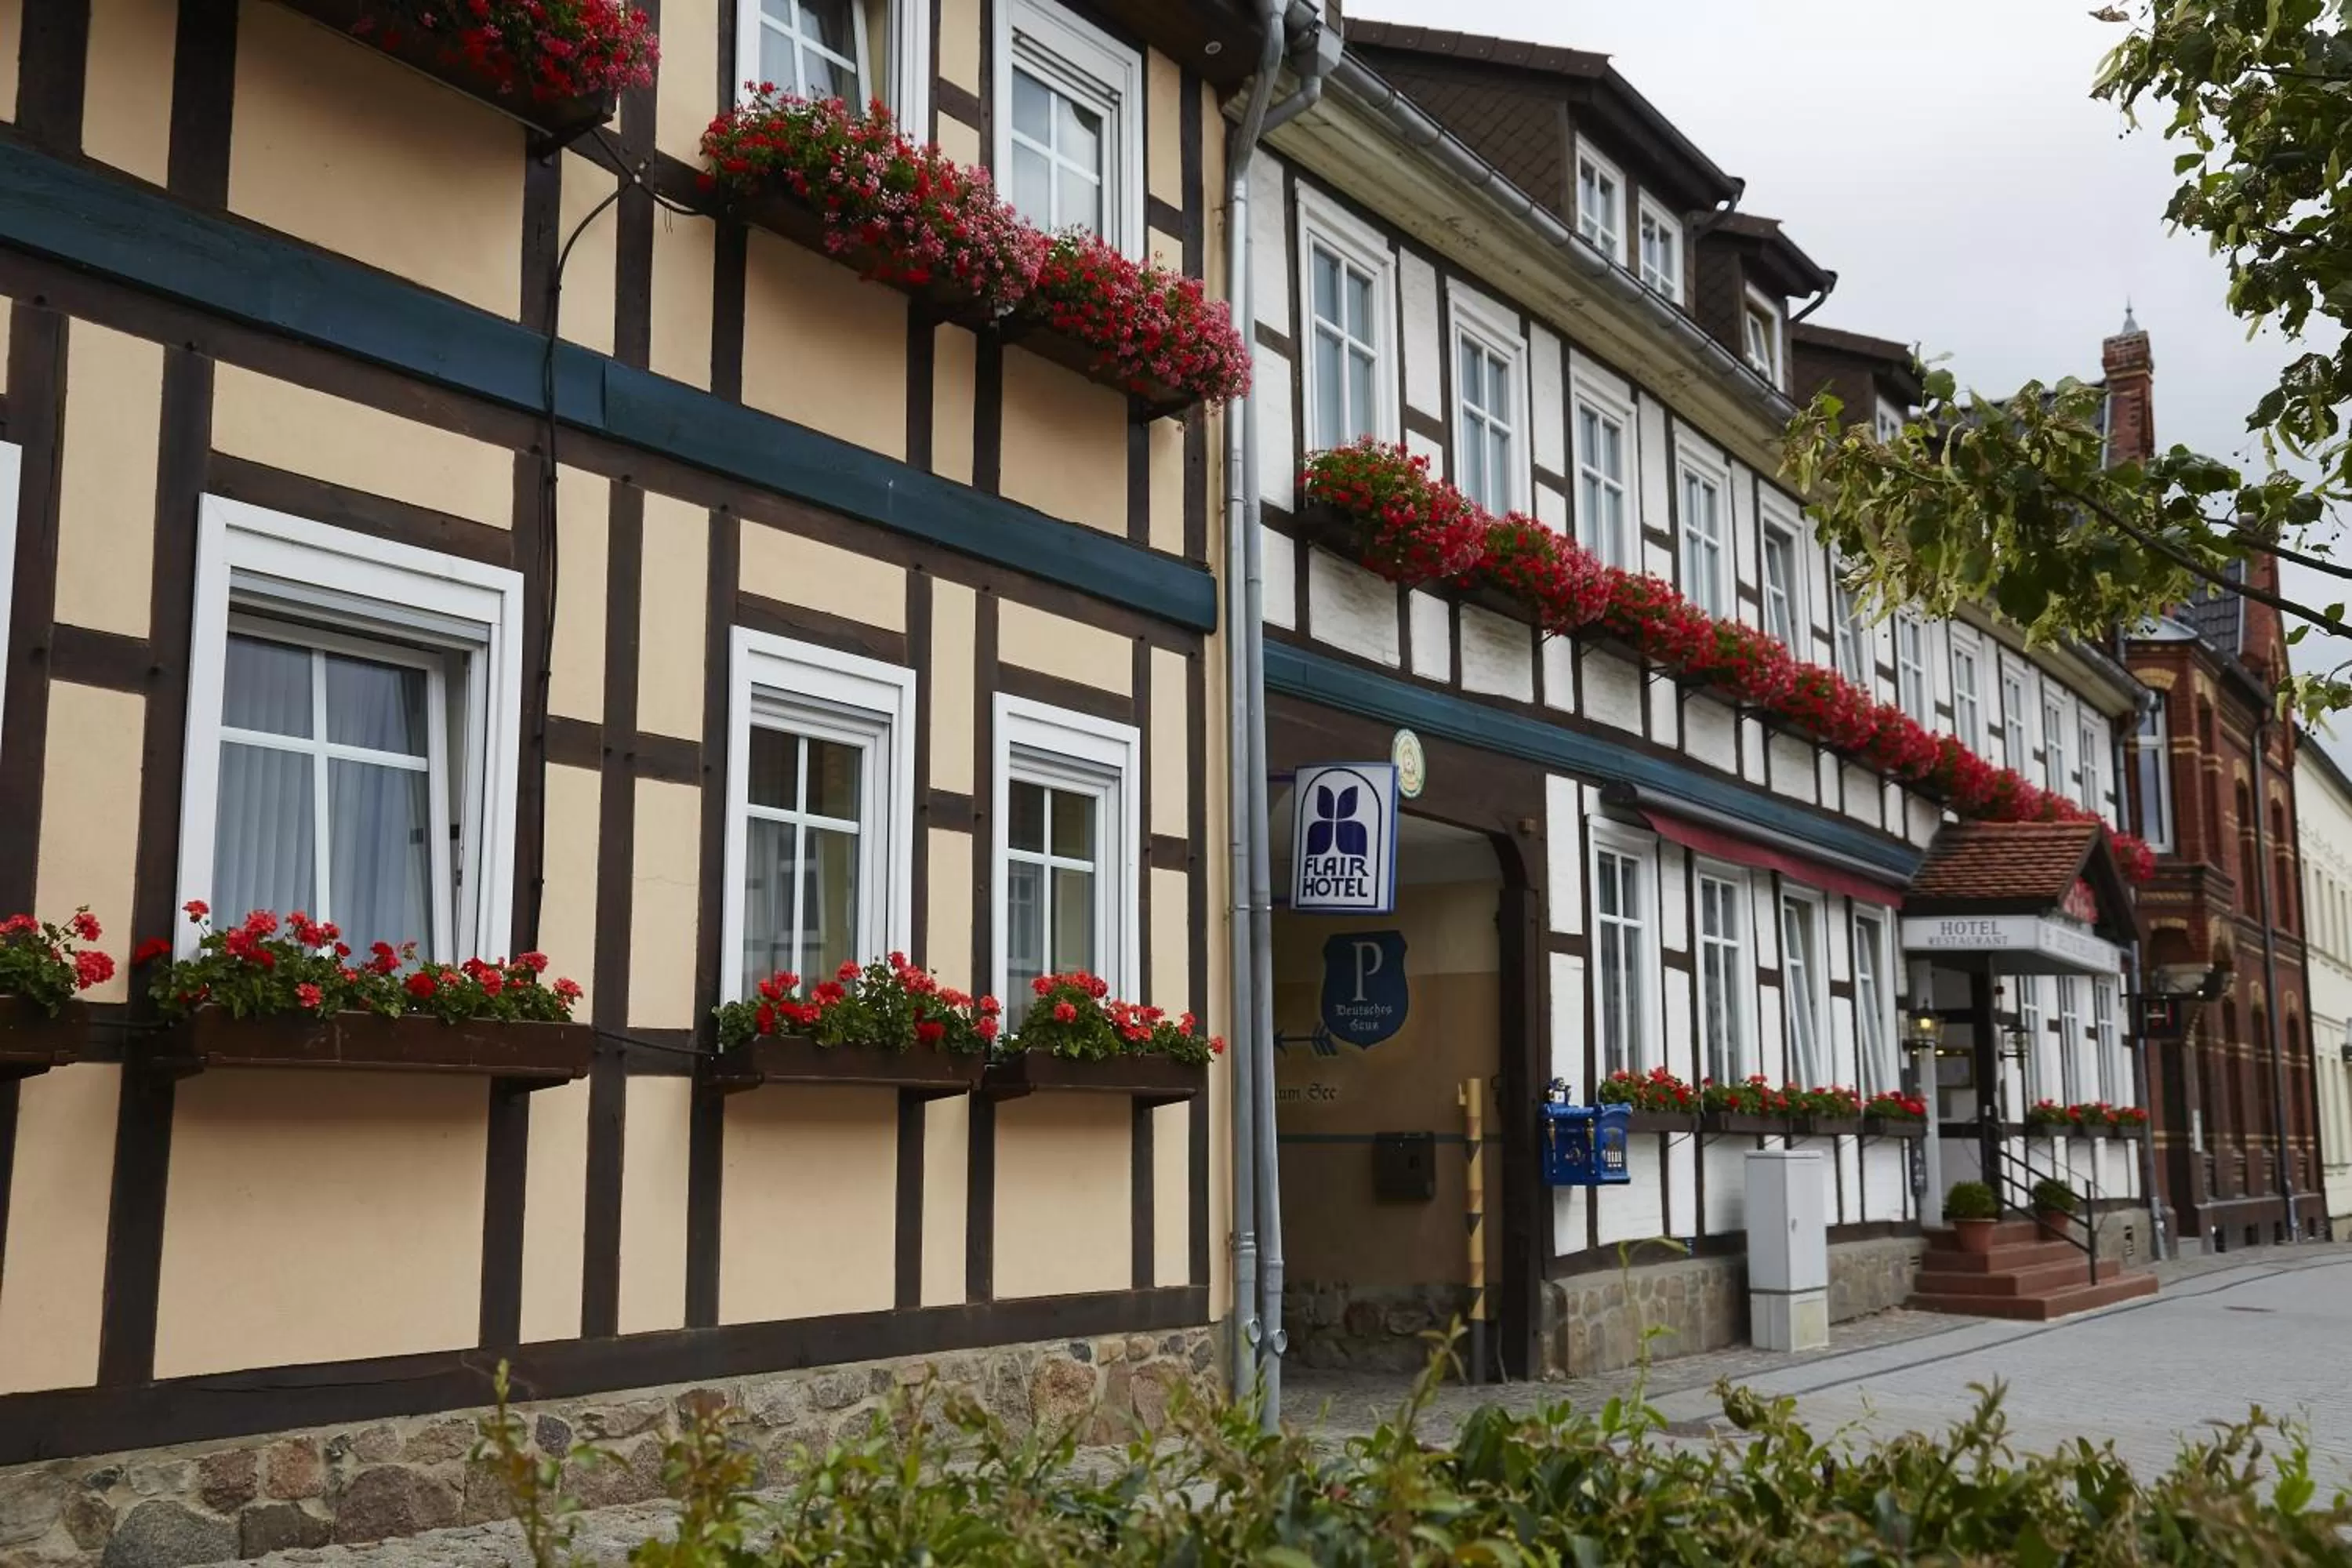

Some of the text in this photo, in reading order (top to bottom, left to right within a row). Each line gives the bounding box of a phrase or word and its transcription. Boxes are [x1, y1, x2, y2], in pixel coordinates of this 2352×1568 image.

[1304, 856, 1369, 877] FLAIR
[1302, 878, 1367, 898] HOTEL
[1940, 920, 2003, 935] HOTEL
[1928, 935, 2008, 946] RESTAURANT
[1351, 941, 1383, 1002] P
[1335, 1004, 1393, 1018] Deutsches
[1276, 1088, 1300, 1102] um
